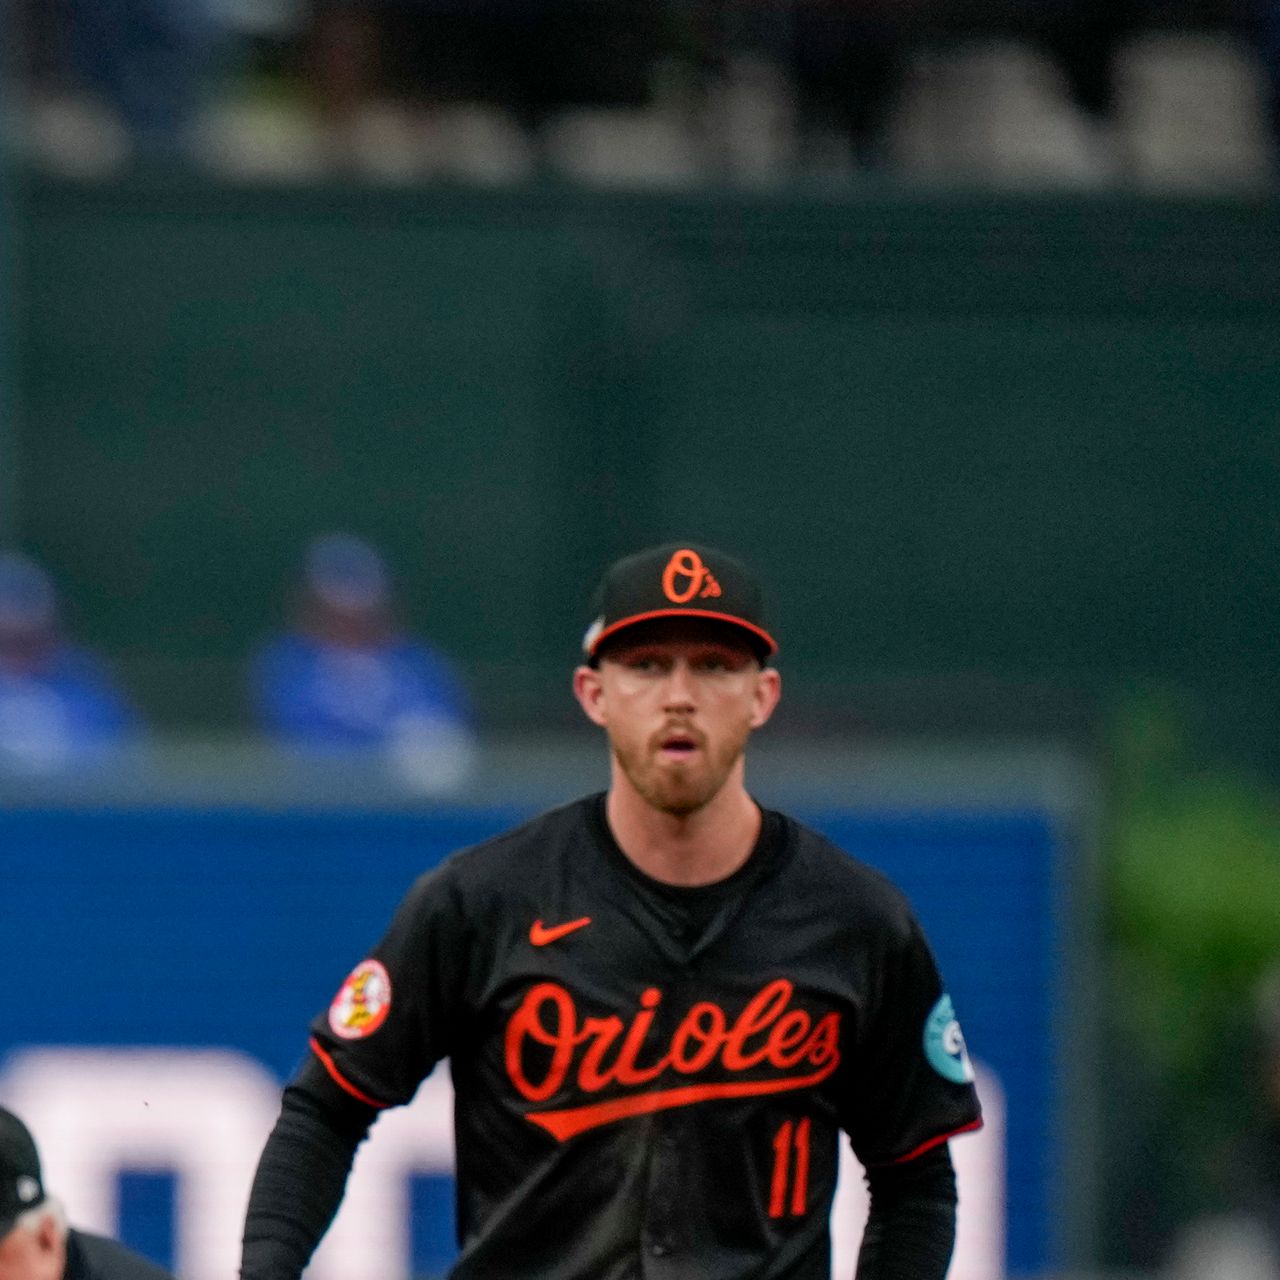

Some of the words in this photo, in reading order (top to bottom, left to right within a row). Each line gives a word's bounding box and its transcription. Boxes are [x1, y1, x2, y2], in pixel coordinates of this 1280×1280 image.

[661, 548, 722, 604] O's
[504, 978, 842, 1106] Orioles
[768, 1117, 811, 1219] 11
